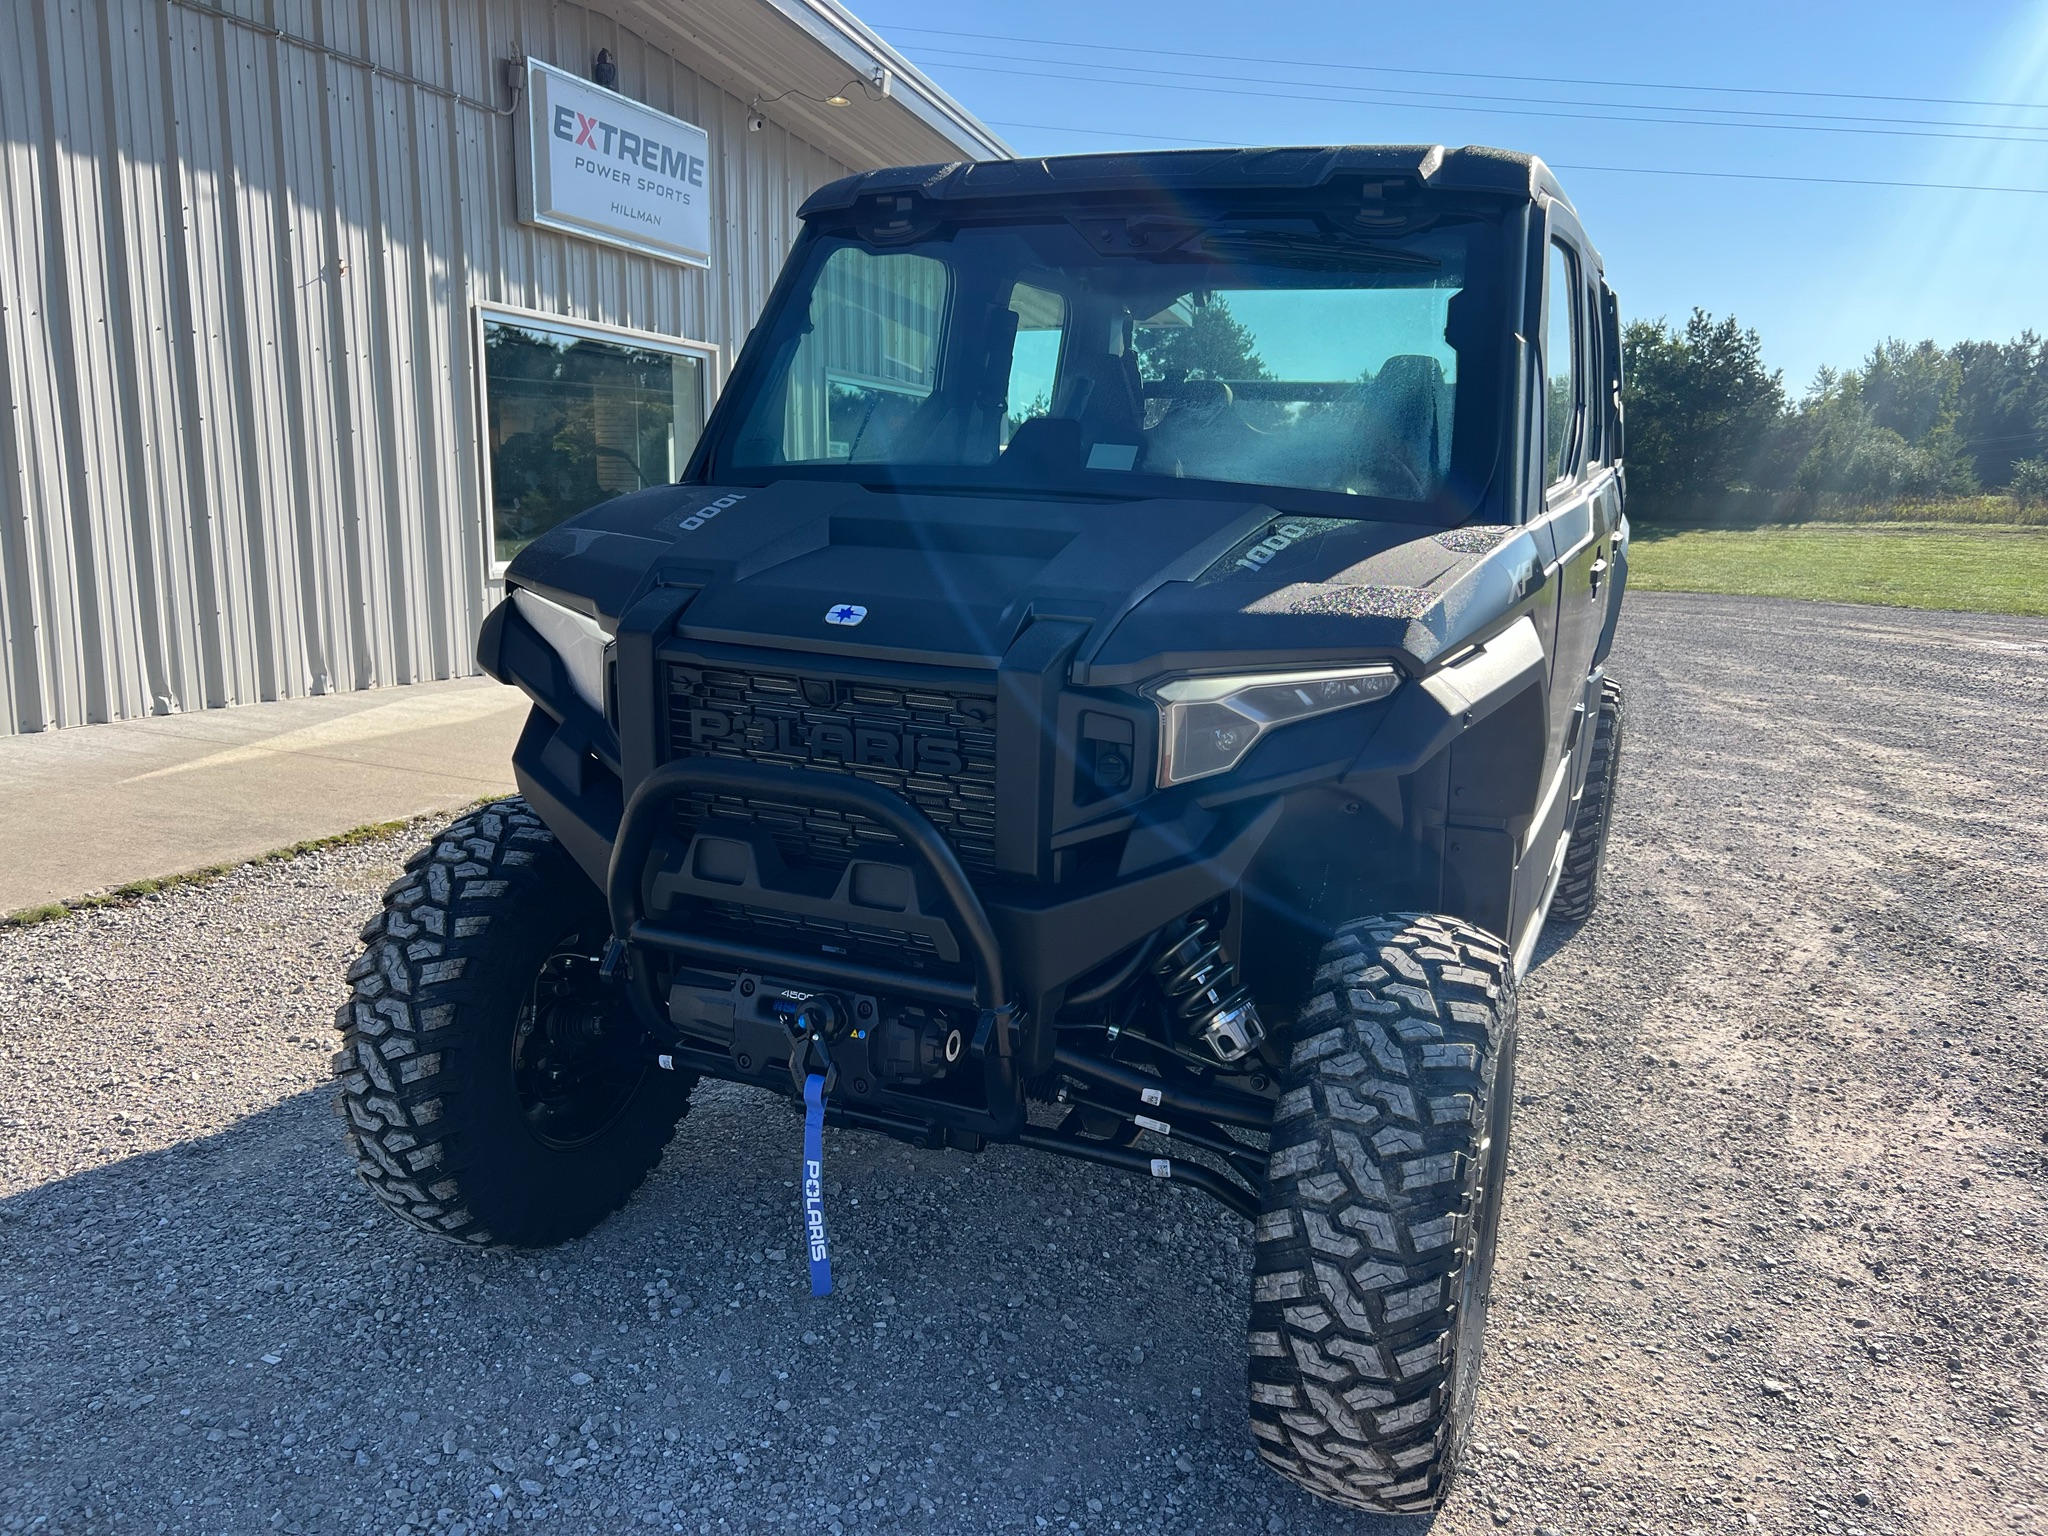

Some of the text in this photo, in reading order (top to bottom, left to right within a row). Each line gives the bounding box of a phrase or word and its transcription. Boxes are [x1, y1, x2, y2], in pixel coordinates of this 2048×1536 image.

[553, 104, 704, 188] EXTREME
[575, 157, 691, 206] POWER SPORTS
[610, 202, 662, 226] HILLMAN
[679, 493, 747, 531] 1000
[1235, 524, 1307, 572] 1000
[1507, 559, 1533, 605] XP
[691, 708, 963, 776] POLARIS
[805, 1160, 827, 1263] POLARIS
